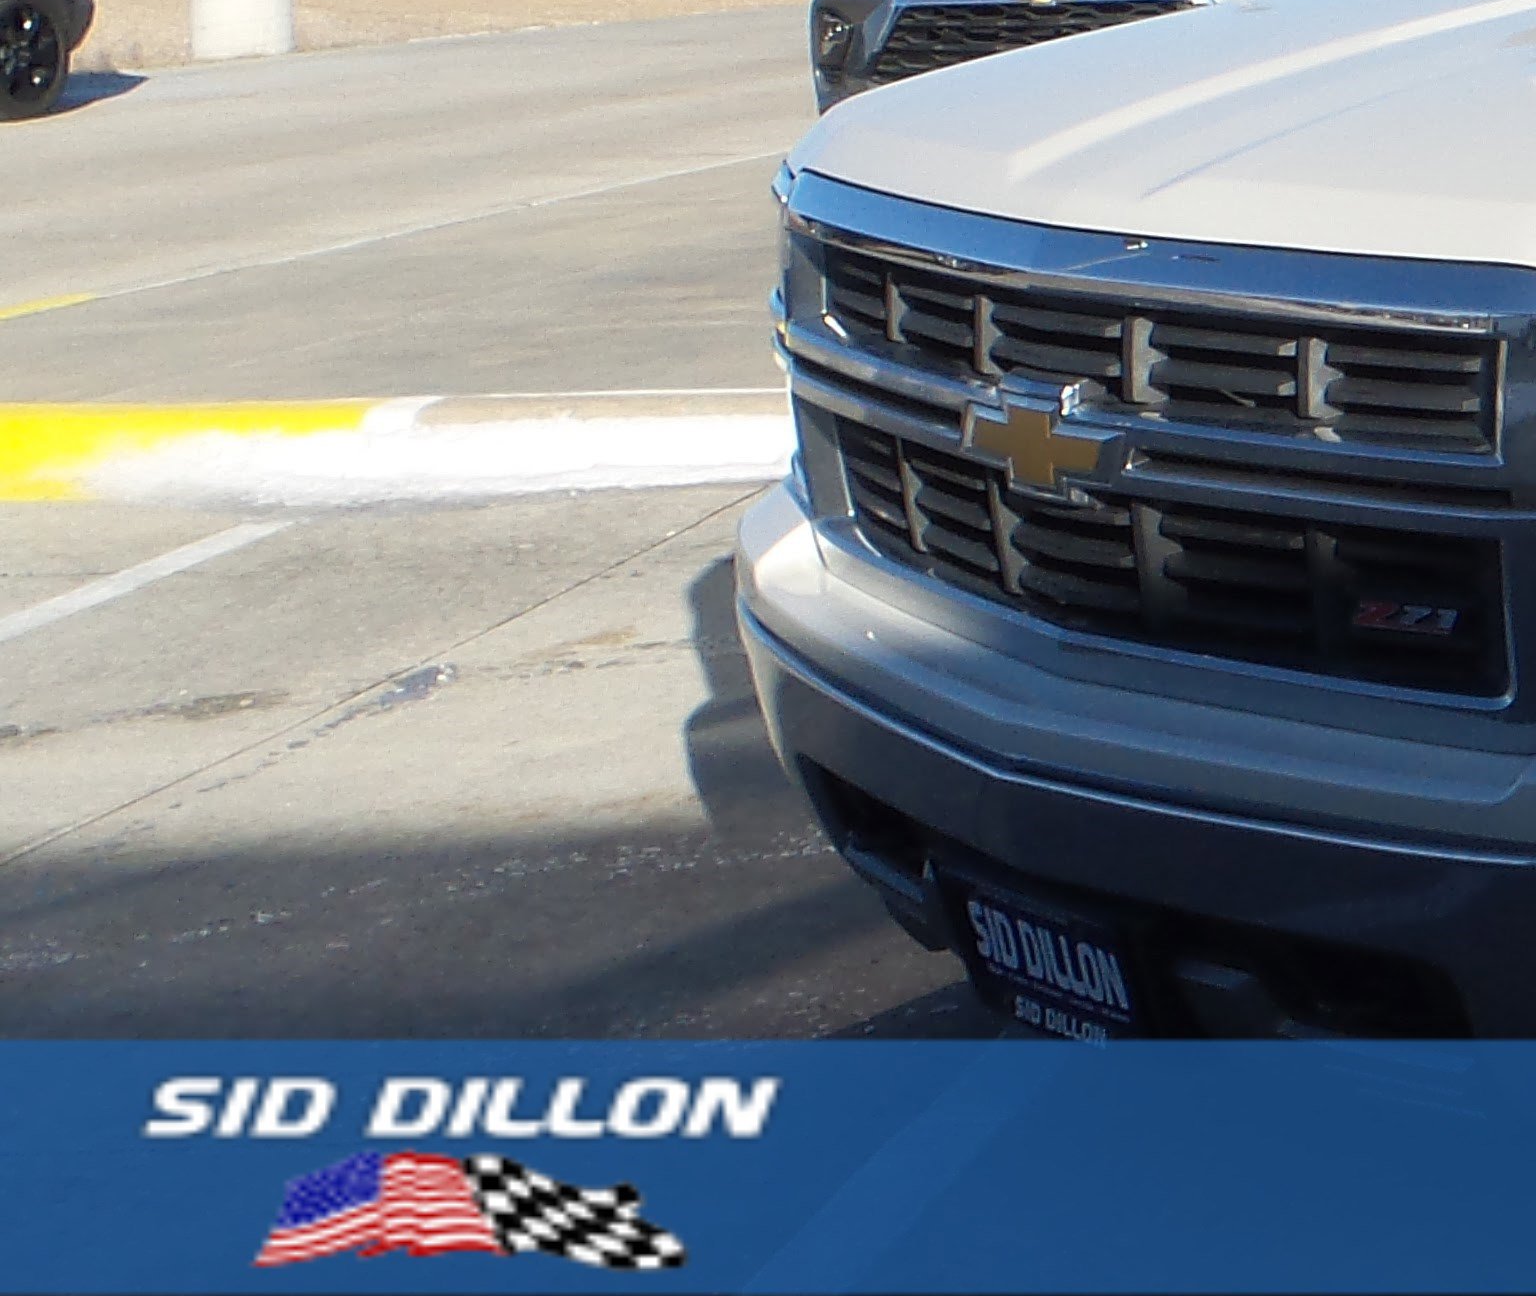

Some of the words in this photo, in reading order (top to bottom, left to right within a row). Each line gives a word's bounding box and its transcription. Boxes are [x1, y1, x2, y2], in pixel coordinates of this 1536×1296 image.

[1353, 602, 1459, 634] Z71
[967, 900, 1020, 970] SID
[1016, 918, 1131, 1011] DILLON
[1014, 994, 1042, 1025] SID
[1044, 1007, 1107, 1048] DILLON
